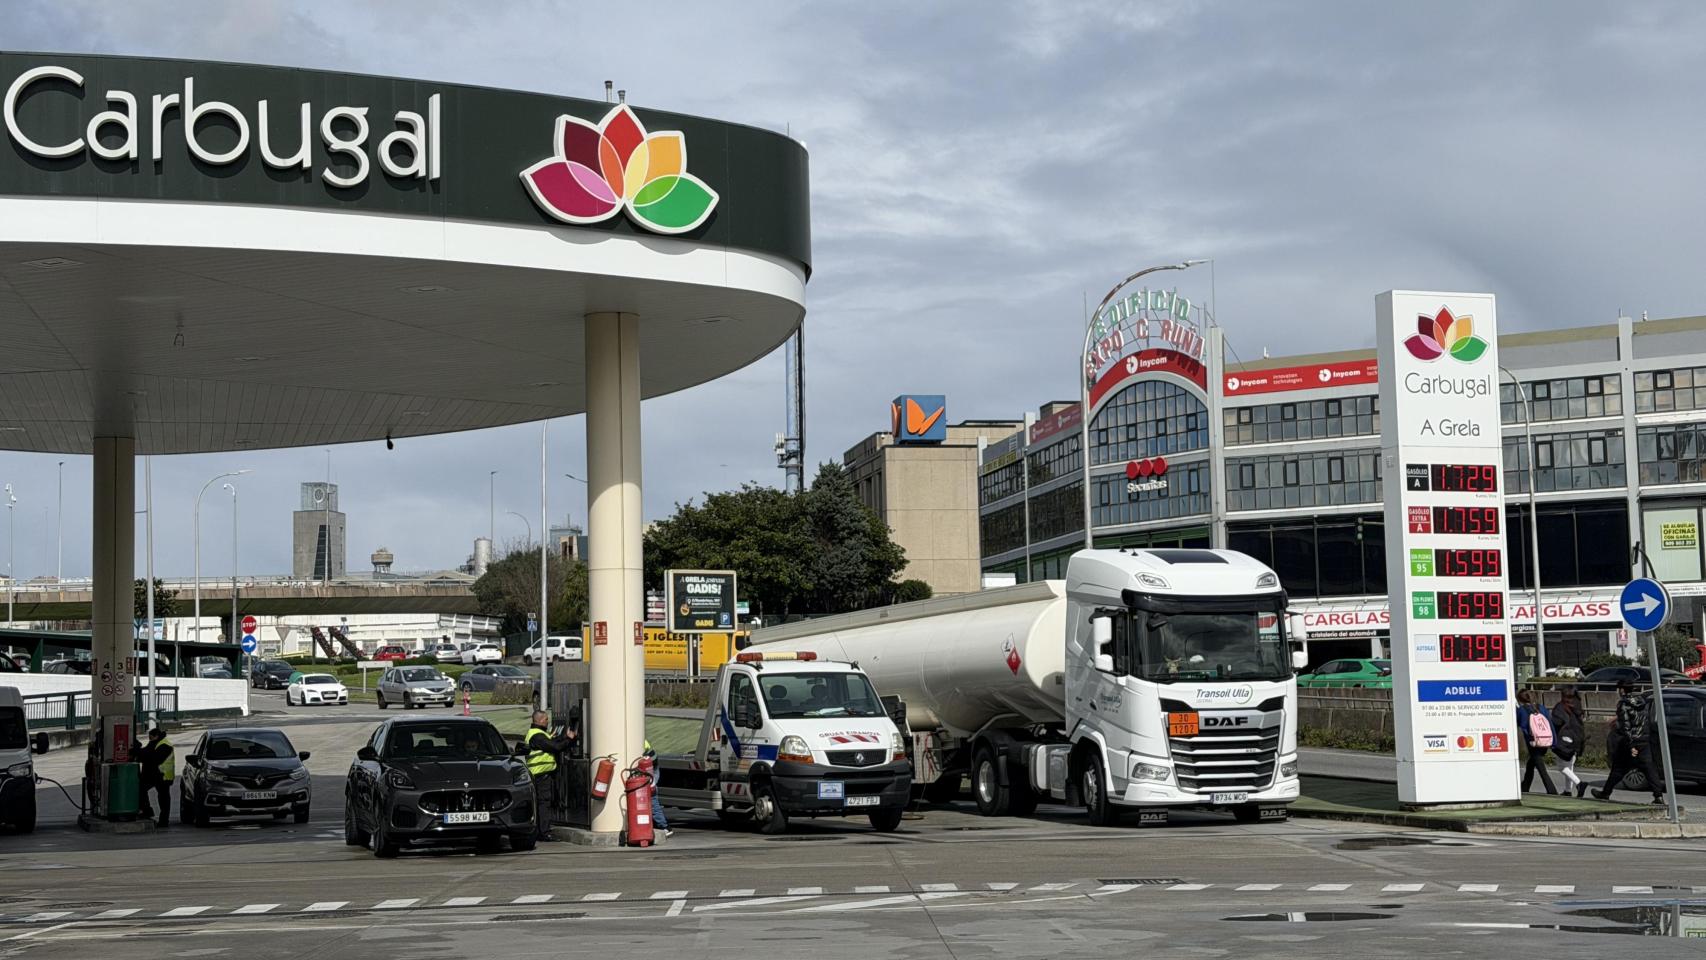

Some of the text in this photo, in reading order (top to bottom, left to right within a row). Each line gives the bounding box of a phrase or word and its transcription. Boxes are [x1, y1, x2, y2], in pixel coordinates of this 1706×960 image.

[3, 65, 441, 188] Carbugal
[1140, 355, 1168, 369] Inycom
[1333, 369, 1361, 379] Inycom
[1241, 377, 1268, 387] Inycom
[1404, 372, 1491, 399] Carbugal
[1420, 418, 1480, 437] A Grela
[1414, 478, 1421, 488] A
[1441, 465, 1495, 492] 1.729
[1443, 507, 1497, 533] 1.759
[1416, 523, 1424, 532] A
[1416, 563, 1427, 573] 95
[1445, 549, 1499, 576] 1.599
[1447, 592, 1501, 618] 1.699
[1418, 606, 1430, 616] 98
[1304, 611, 1390, 626] CARGLAS
[1442, 635, 1504, 661] 0.799
[103, 662, 110, 670] 4
[117, 662, 124, 670] 3
[1196, 687, 1250, 698] Transoil Ulla
[1444, 686, 1482, 695] ADBLUE
[1178, 713, 1189, 723] 30
[1203, 716, 1249, 727] DAF
[1174, 723, 1195, 734] 1202
[1427, 740, 1446, 748] VISA
[449, 812, 488, 823] 5598 MZG
[1260, 809, 1287, 817] DAF
